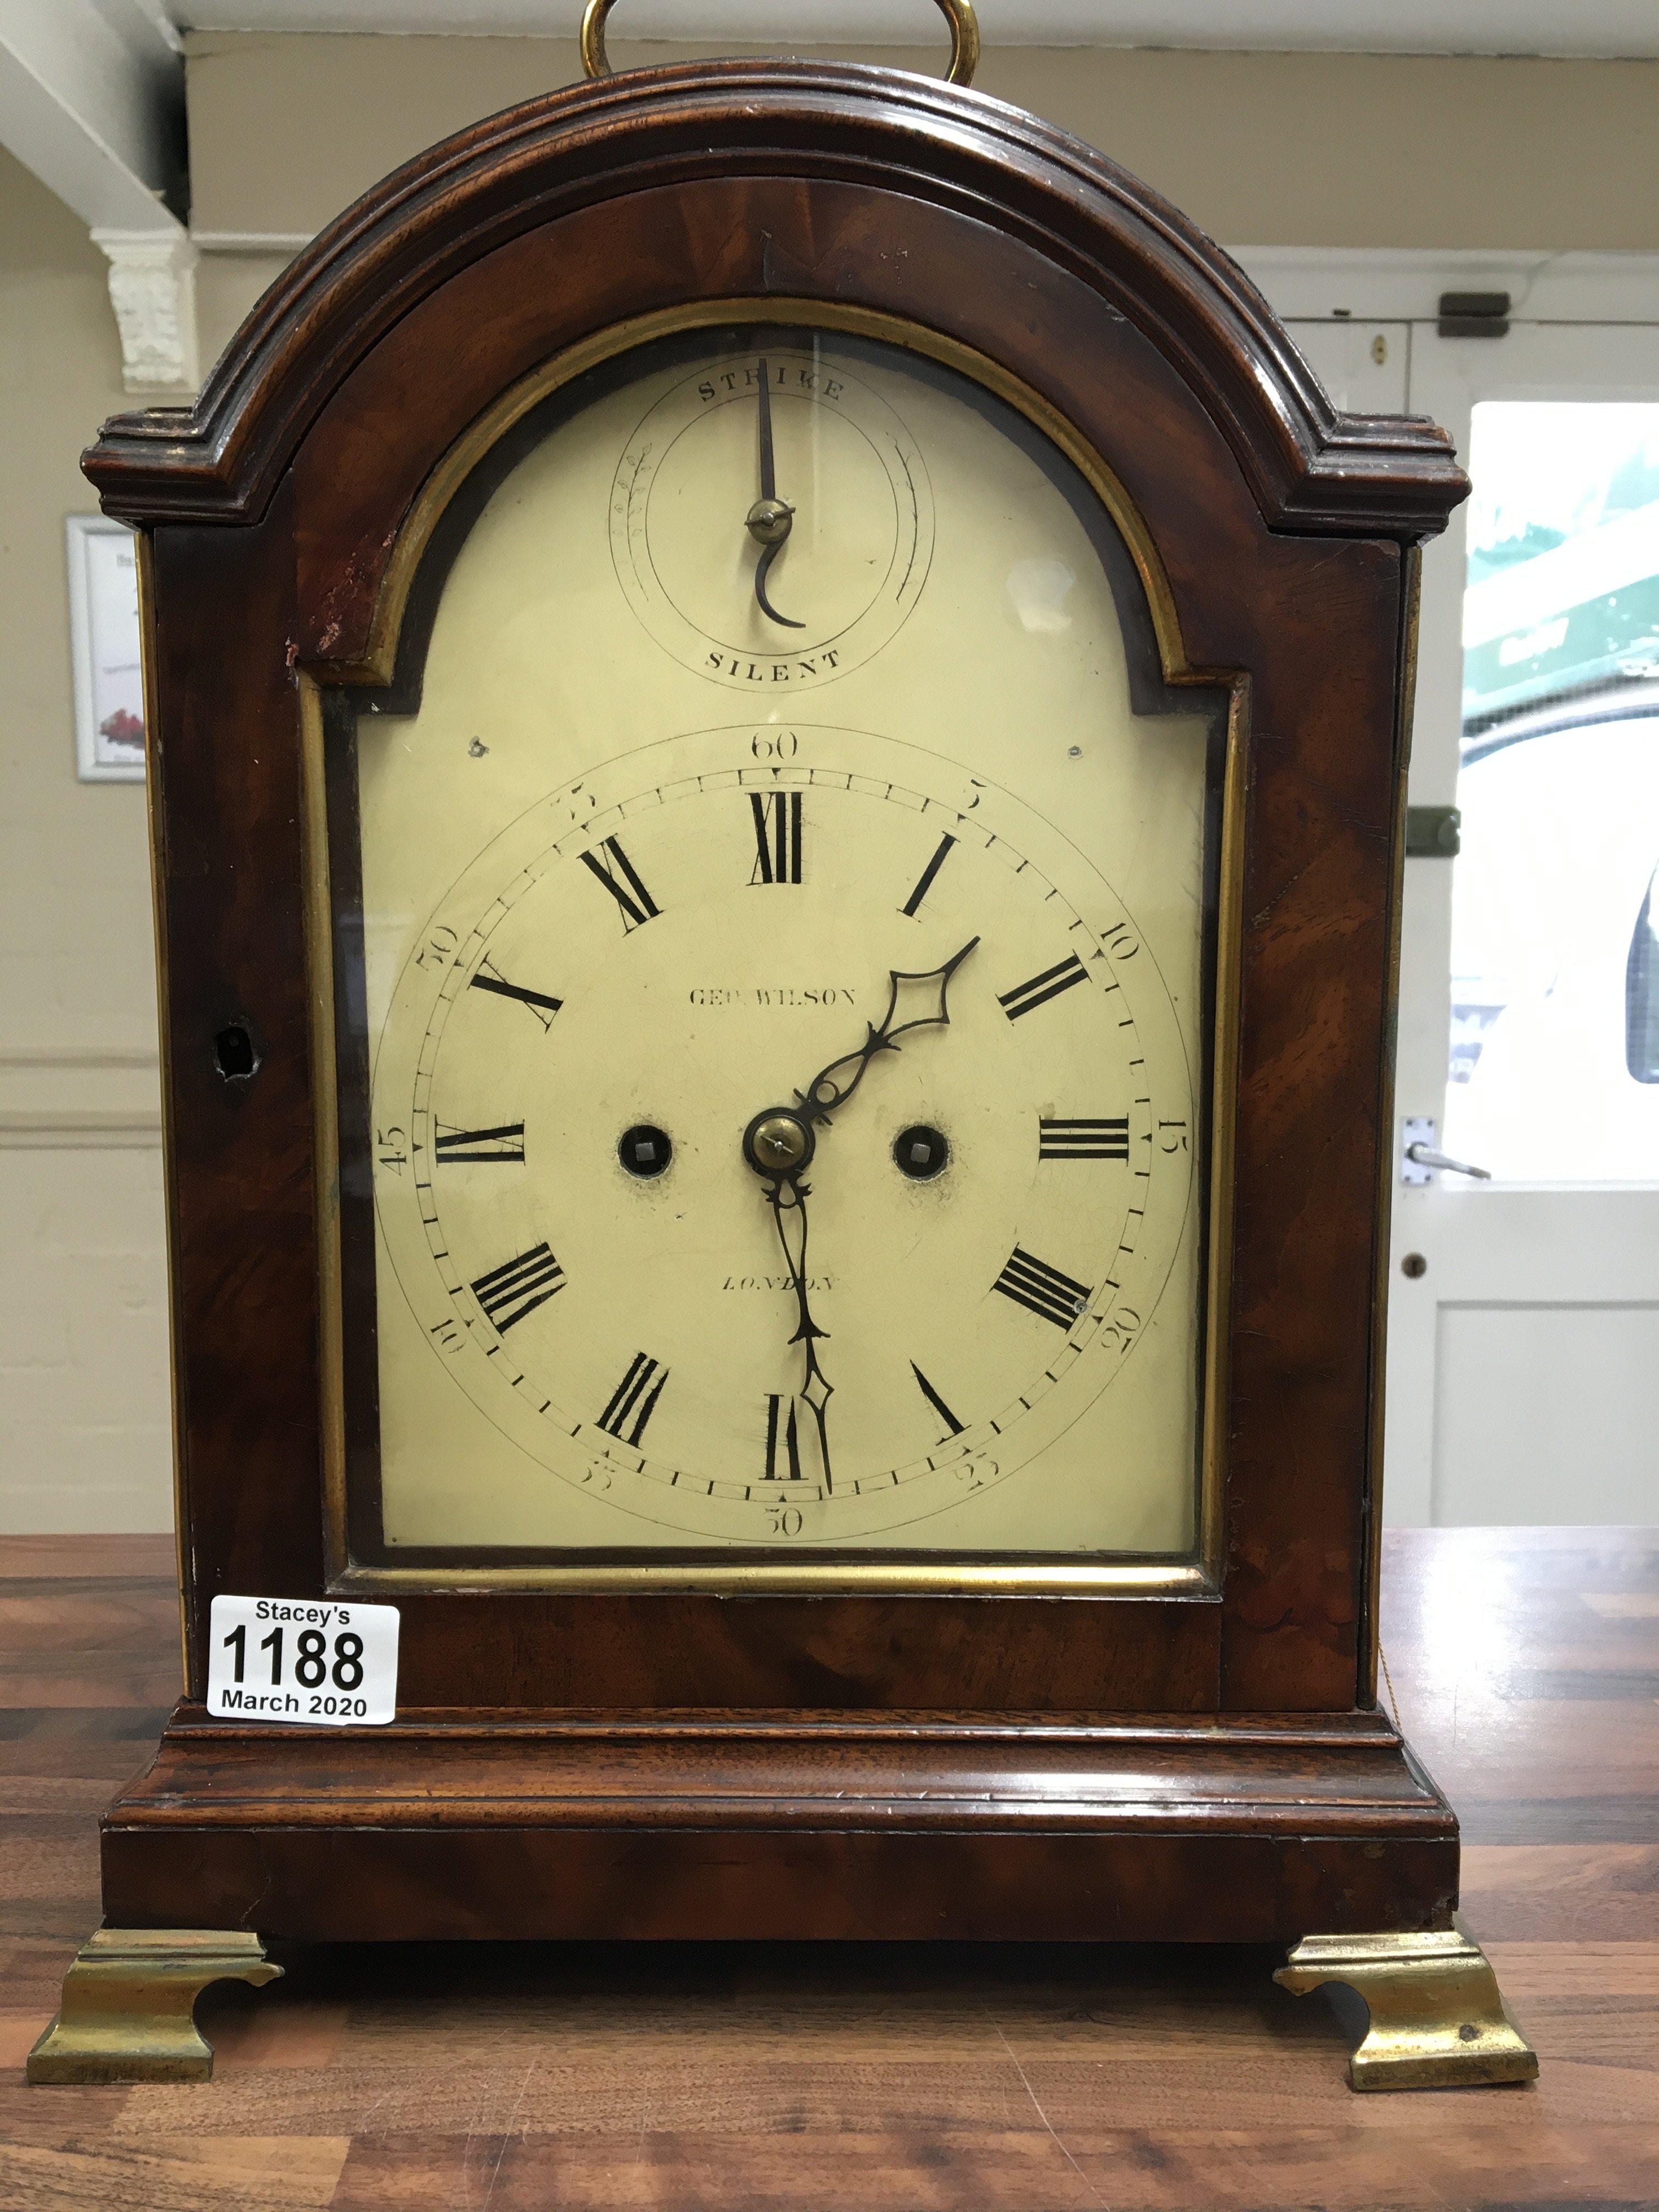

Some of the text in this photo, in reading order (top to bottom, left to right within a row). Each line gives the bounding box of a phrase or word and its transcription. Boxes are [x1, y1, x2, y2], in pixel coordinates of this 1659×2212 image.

[698, 366, 844, 402] STRIKE
[704, 649, 839, 682] SILENT
[751, 731, 797, 760] 60
[744, 791, 803, 887] XII
[575, 832, 665, 938] XI
[896, 830, 961, 923] I
[1099, 922, 1139, 960] 10
[466, 949, 566, 1035] X
[995, 948, 1093, 1027] II
[378, 1127, 407, 1177] 45
[435, 1114, 526, 1167] IX
[1038, 1113, 1129, 1167] III
[1159, 1119, 1188, 1153] 15
[1100, 1307, 1141, 1356] 20
[255, 1601, 350, 1628] Stacey's
[223, 1624, 363, 1691] 1188
[221, 1689, 367, 1717] March 2020
